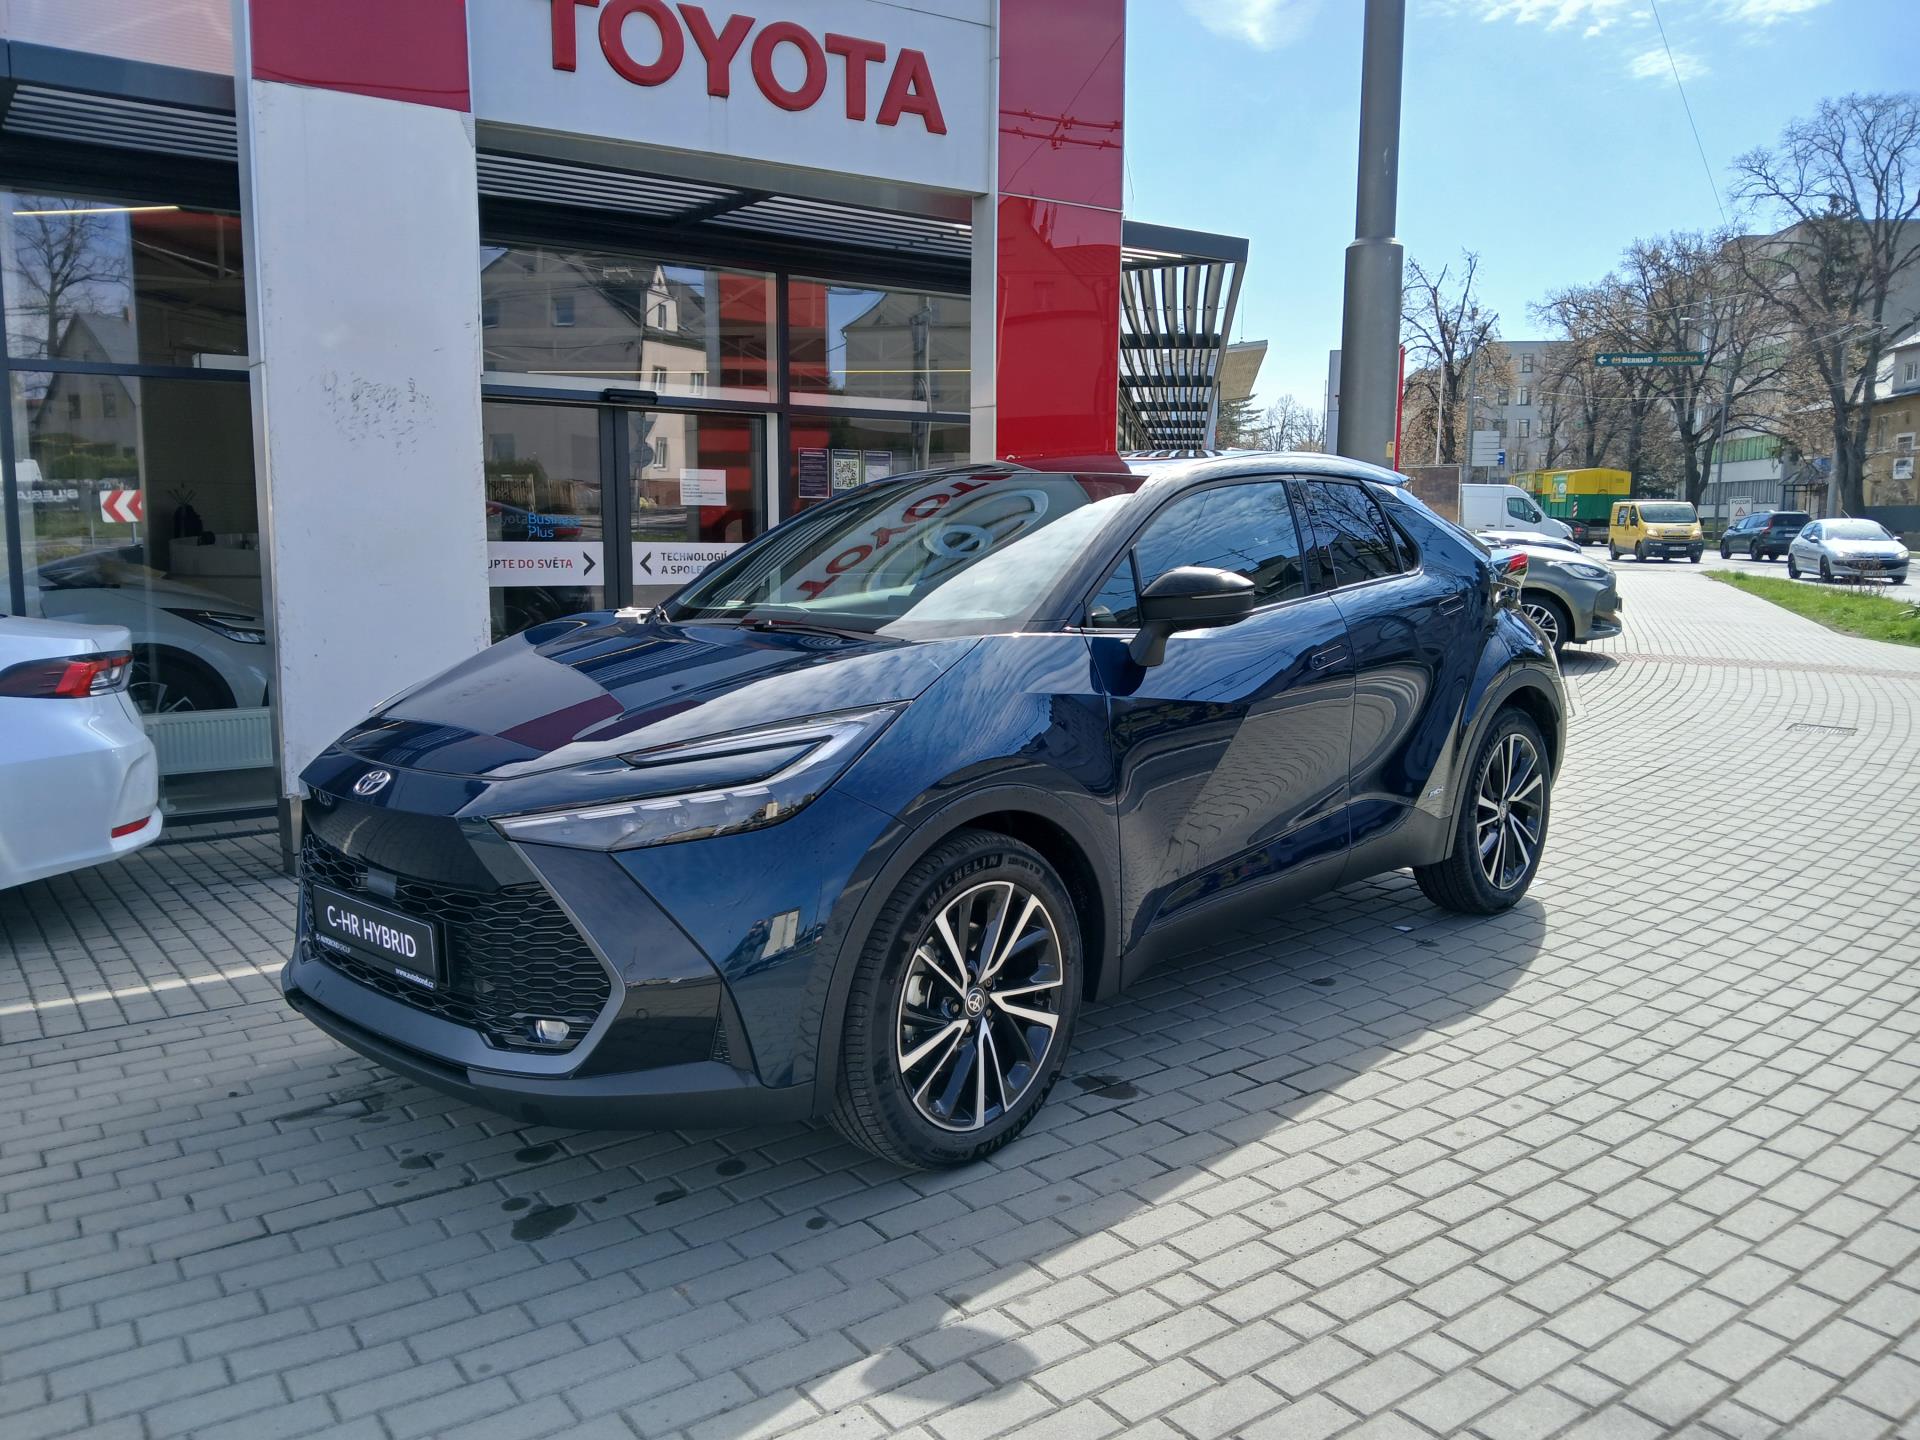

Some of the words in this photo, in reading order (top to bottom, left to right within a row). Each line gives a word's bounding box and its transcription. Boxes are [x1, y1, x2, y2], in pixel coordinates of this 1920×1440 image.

[550, 0, 947, 135] TOYOTA
[528, 526, 554, 538] Plus
[518, 559, 535, 568] DO
[537, 557, 573, 568] SVĚTA
[661, 565, 668, 575] A
[671, 565, 705, 575] SPOLE
[926, 854, 999, 909] MICHELIN
[327, 905, 361, 938] C-HR
[362, 918, 417, 958] HYBRID
